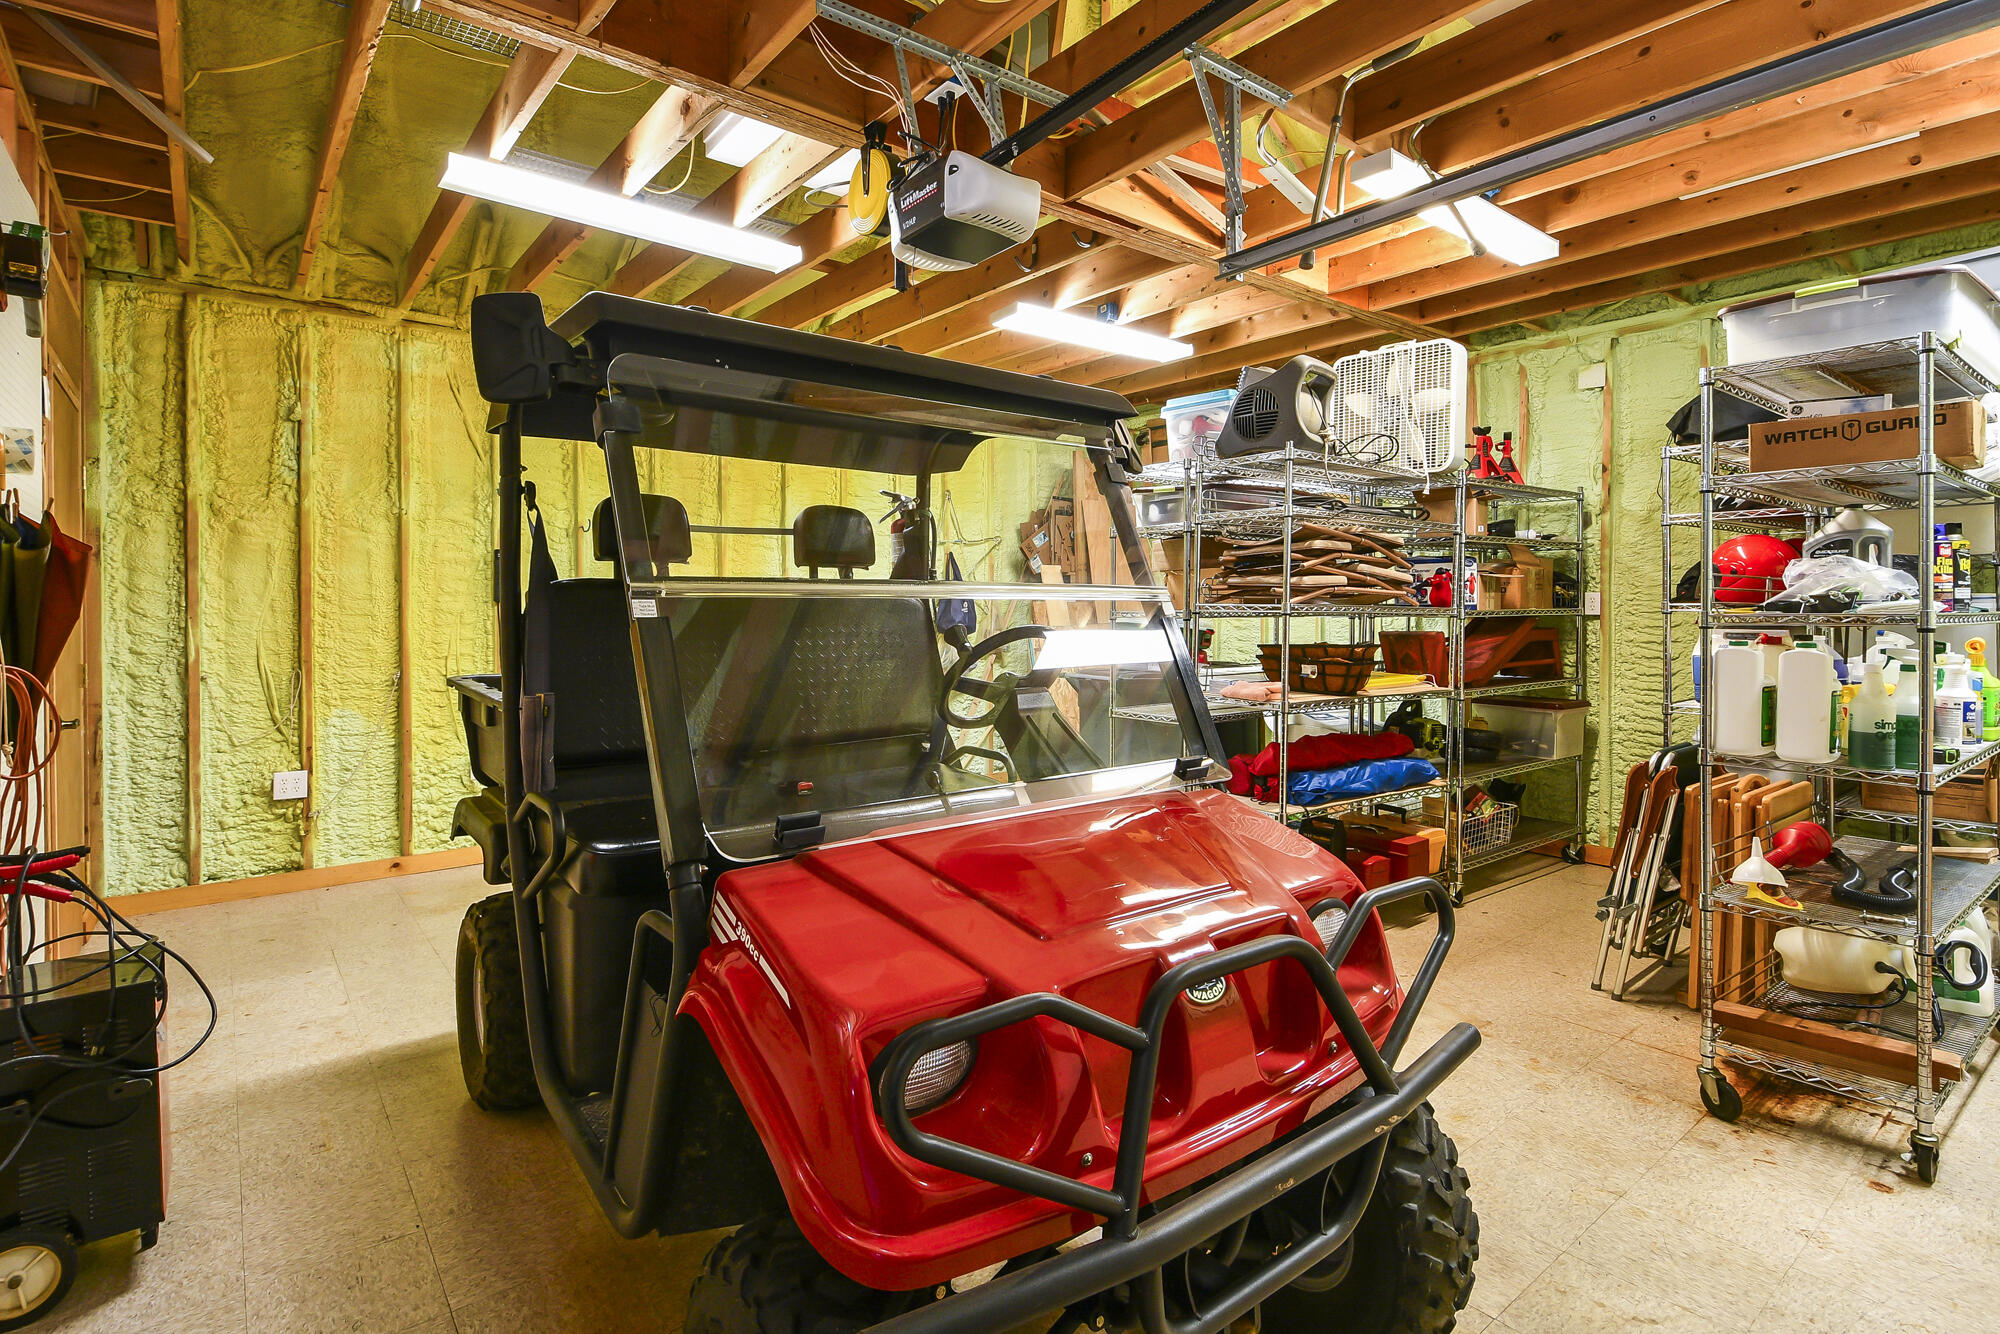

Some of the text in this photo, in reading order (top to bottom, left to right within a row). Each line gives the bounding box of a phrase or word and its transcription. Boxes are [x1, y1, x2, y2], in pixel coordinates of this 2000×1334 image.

[900, 181, 938, 209] LiftMaster
[1764, 426, 1838, 446] WATCH
[735, 921, 759, 962] 390cc
[1193, 980, 1223, 1000] WAGON
